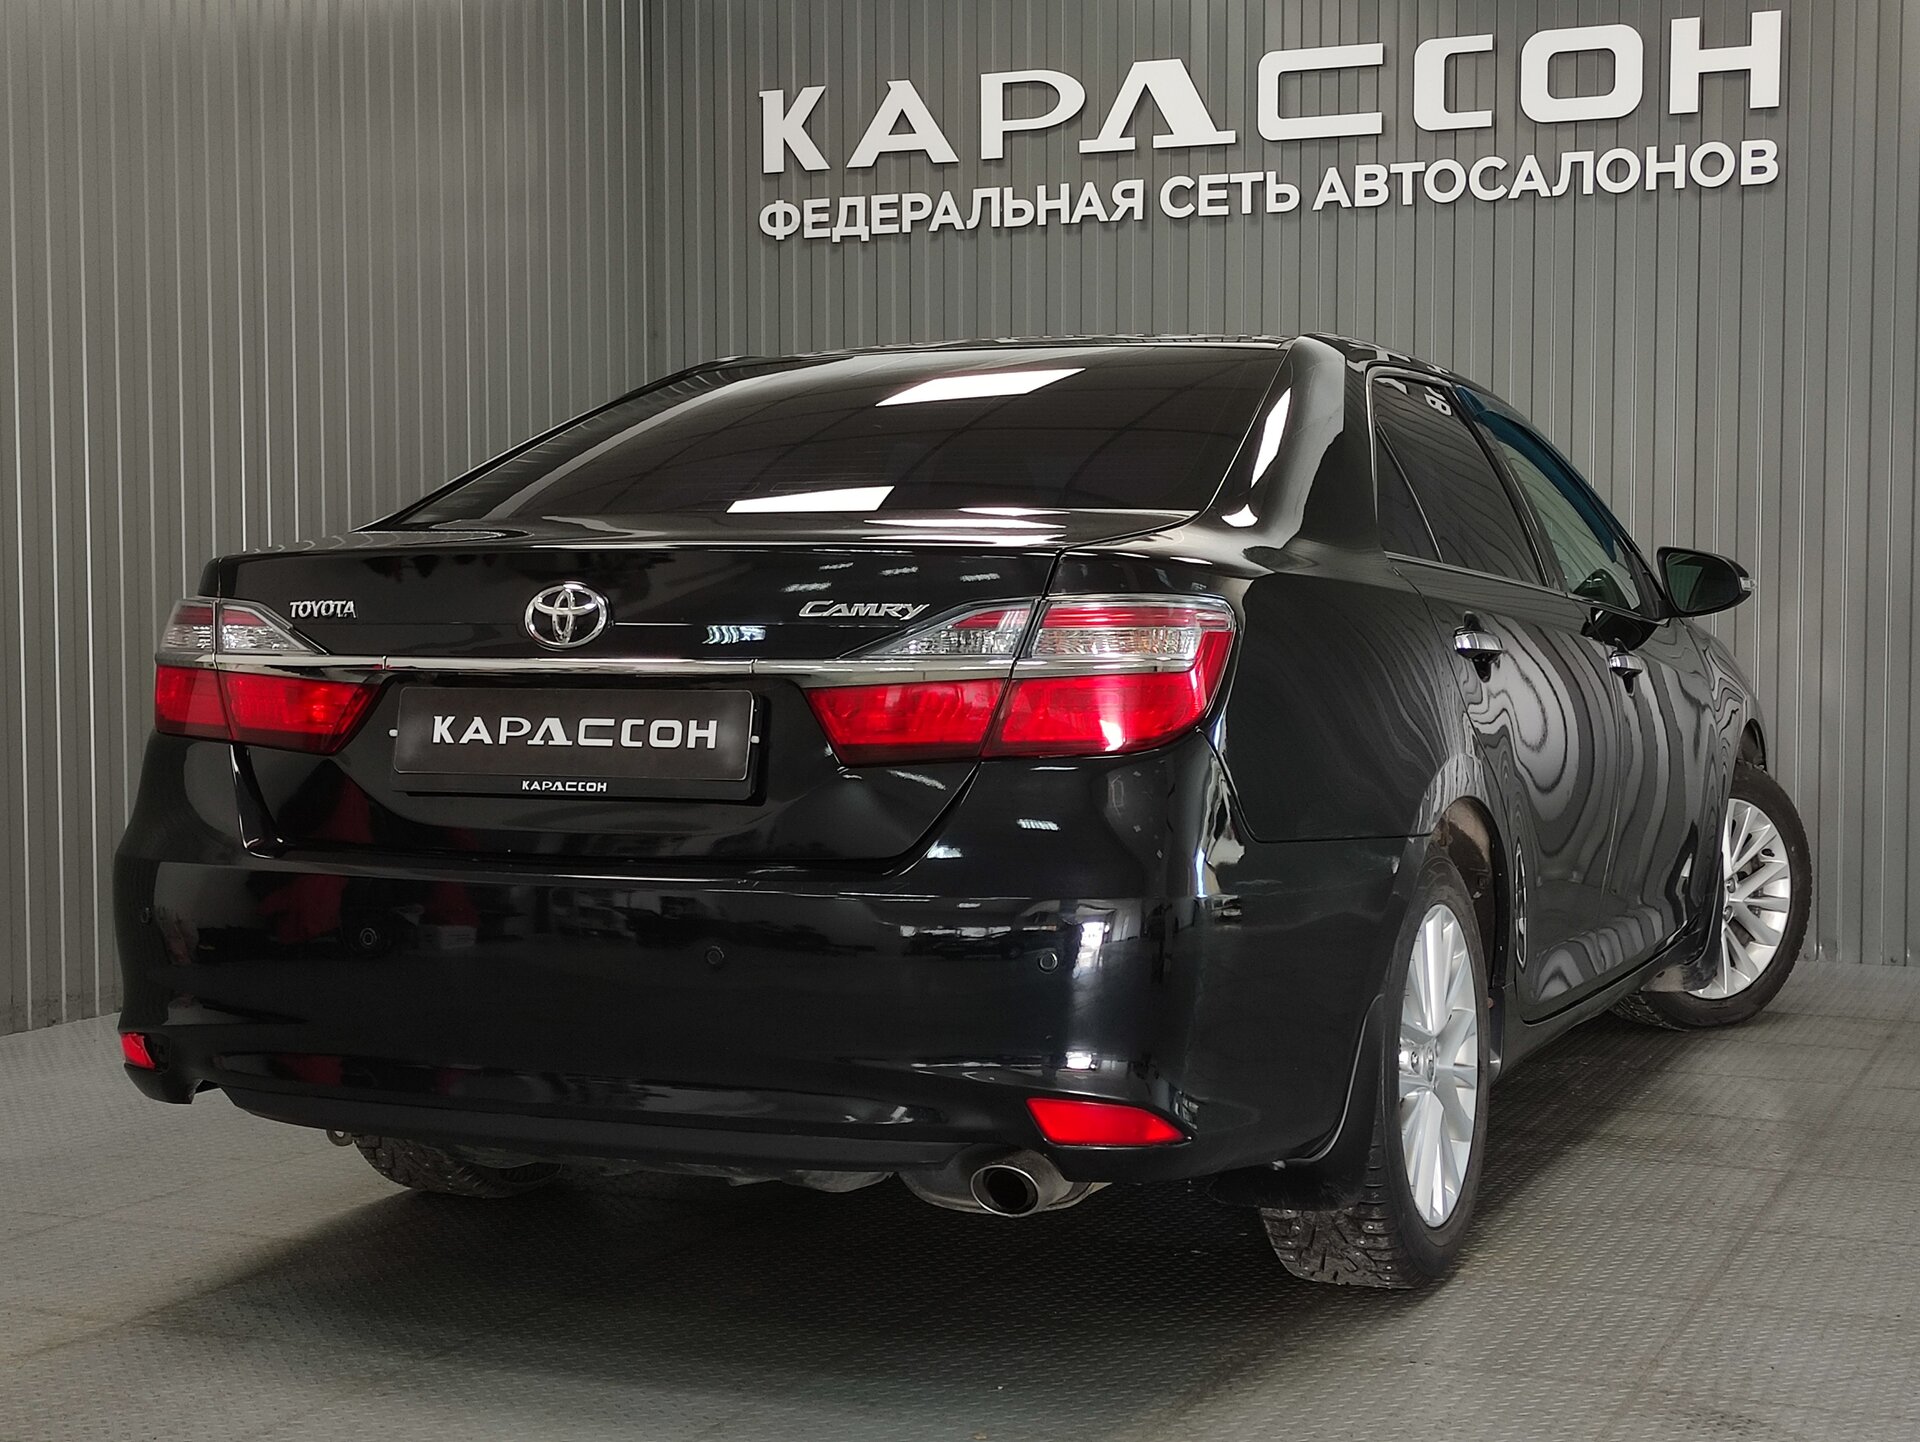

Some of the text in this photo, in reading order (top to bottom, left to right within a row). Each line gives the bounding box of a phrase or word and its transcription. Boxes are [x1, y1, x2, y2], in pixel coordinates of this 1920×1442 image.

[759, 139, 1780, 243] ФЕДЕРАЛЬНАЯ СЕТЬ АВТОСАЛОНОВ
[290, 599, 356, 618] TOYOTA
[799, 600, 930, 620] CAMRY
